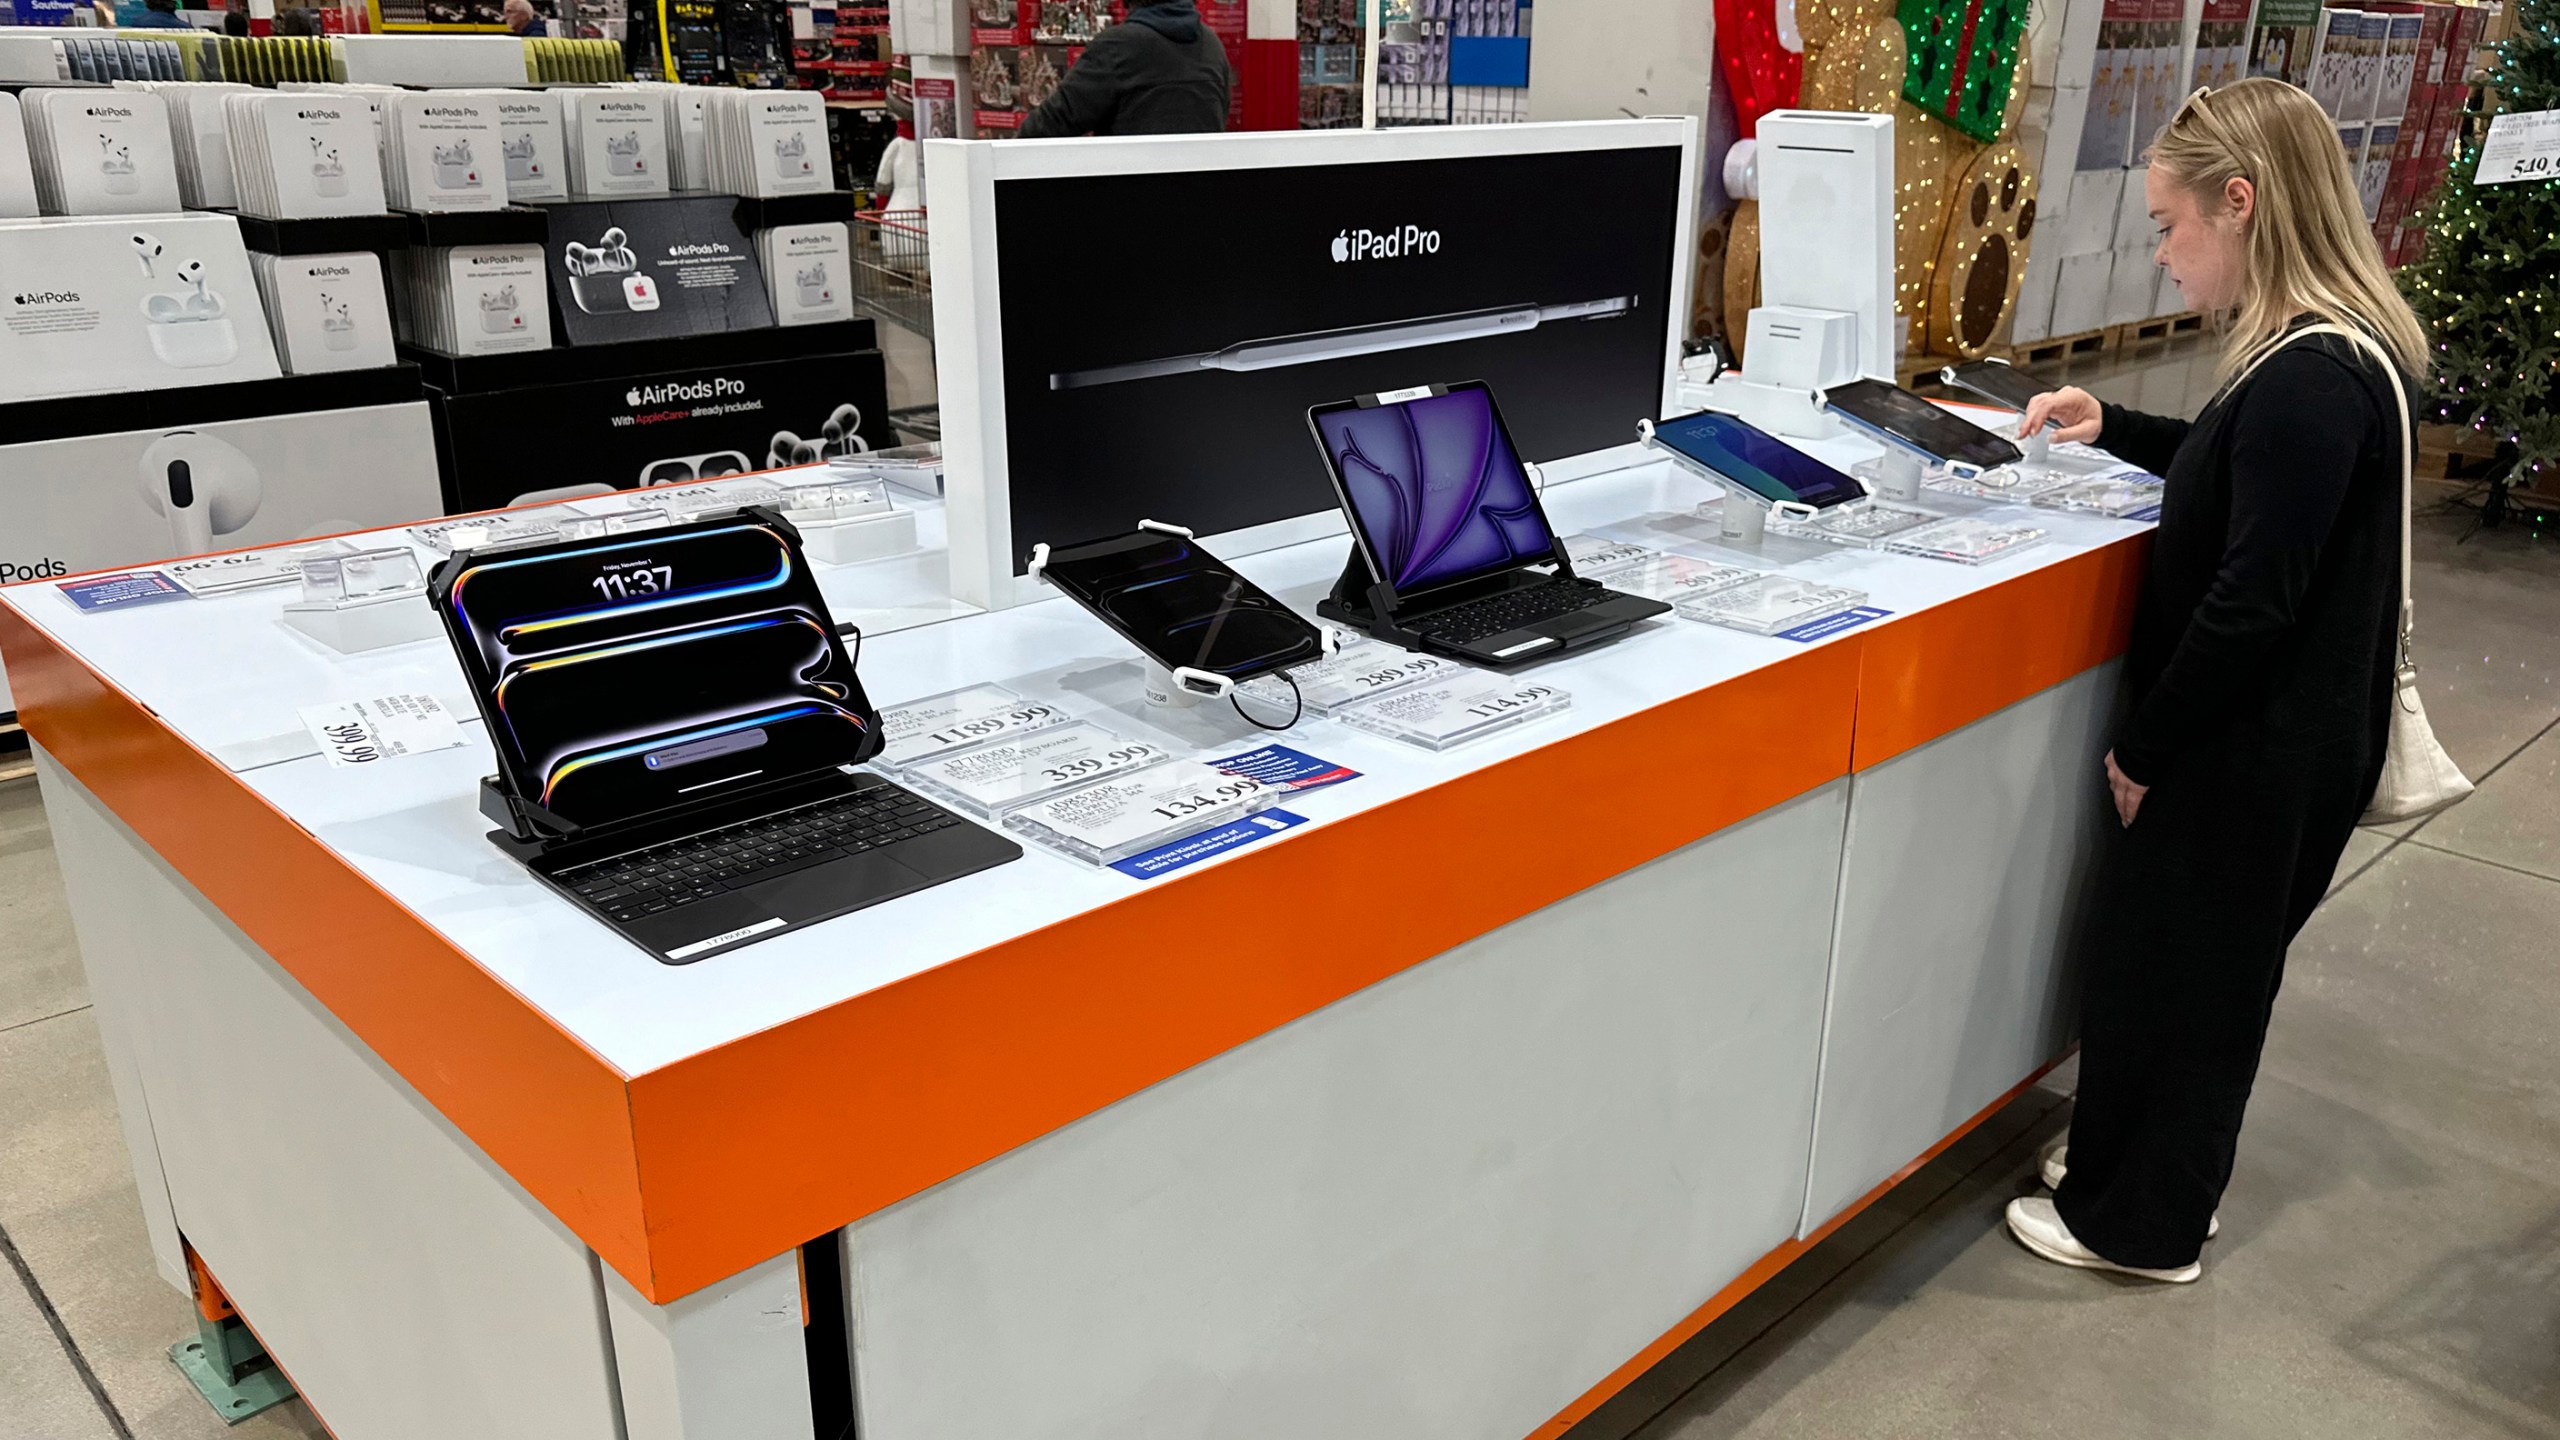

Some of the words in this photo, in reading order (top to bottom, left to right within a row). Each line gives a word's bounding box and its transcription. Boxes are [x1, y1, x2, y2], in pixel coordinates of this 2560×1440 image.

[31, 0, 75, 10] Southwe
[94, 107, 132, 117] AirPods
[305, 109, 341, 120] AirPods
[431, 108, 462, 117] AirPods
[464, 107, 479, 116] Pro
[527, 105, 540, 113] Pro
[606, 103, 632, 112] AirPods
[634, 103, 646, 111] Pro
[772, 105, 797, 113] AirPods
[798, 104, 809, 112] Pro
[677, 244, 713, 255] AirPods
[713, 243, 729, 253] Pro
[796, 237, 822, 245] AirPods
[1351, 225, 1400, 261] iPad
[1404, 224, 1440, 256] Pro
[479, 255, 509, 264] AirPods
[510, 255, 524, 263] Pro
[316, 266, 350, 277] AirPods
[27, 291, 80, 304] AirPods
[642, 380, 713, 405] AirPods
[714, 377, 745, 397] Pro
[611, 415, 635, 427] With
[635, 410, 690, 425] AppleCare+
[691, 404, 724, 417] already
[724, 399, 764, 413] included.
[0, 557, 67, 584] Pods
[172, 553, 262, 575] 79.99
[602, 564, 622, 572] Friday,
[620, 560, 648, 569] November
[592, 565, 673, 602] 11:37
[95, 594, 142, 606] ONLINE
[1355, 658, 1440, 688] 289.99
[1465, 686, 1552, 718] 114.99
[926, 705, 1051, 745] 1189.99
[323, 722, 380, 763] 399.99
[1017, 736, 1079, 753] KEYBOARD
[942, 745, 1017, 769] 1778000
[1041, 742, 1151, 782] 339.99
[1236, 750, 1275, 763] ONLINE
[1044, 783, 1120, 811] 1085308
[1151, 780, 1259, 820] 134.99
[1135, 859, 1156, 868] See
[1154, 850, 1177, 862] Print
[1175, 842, 1202, 855] Kiosk
[1201, 838, 1213, 846] at
[1212, 832, 1229, 842] end
[1228, 828, 1239, 837] of
[1143, 861, 1170, 872] table
[1168, 855, 1183, 864] for
[1182, 841, 1225, 860] purchase
[1223, 830, 1257, 844] options
